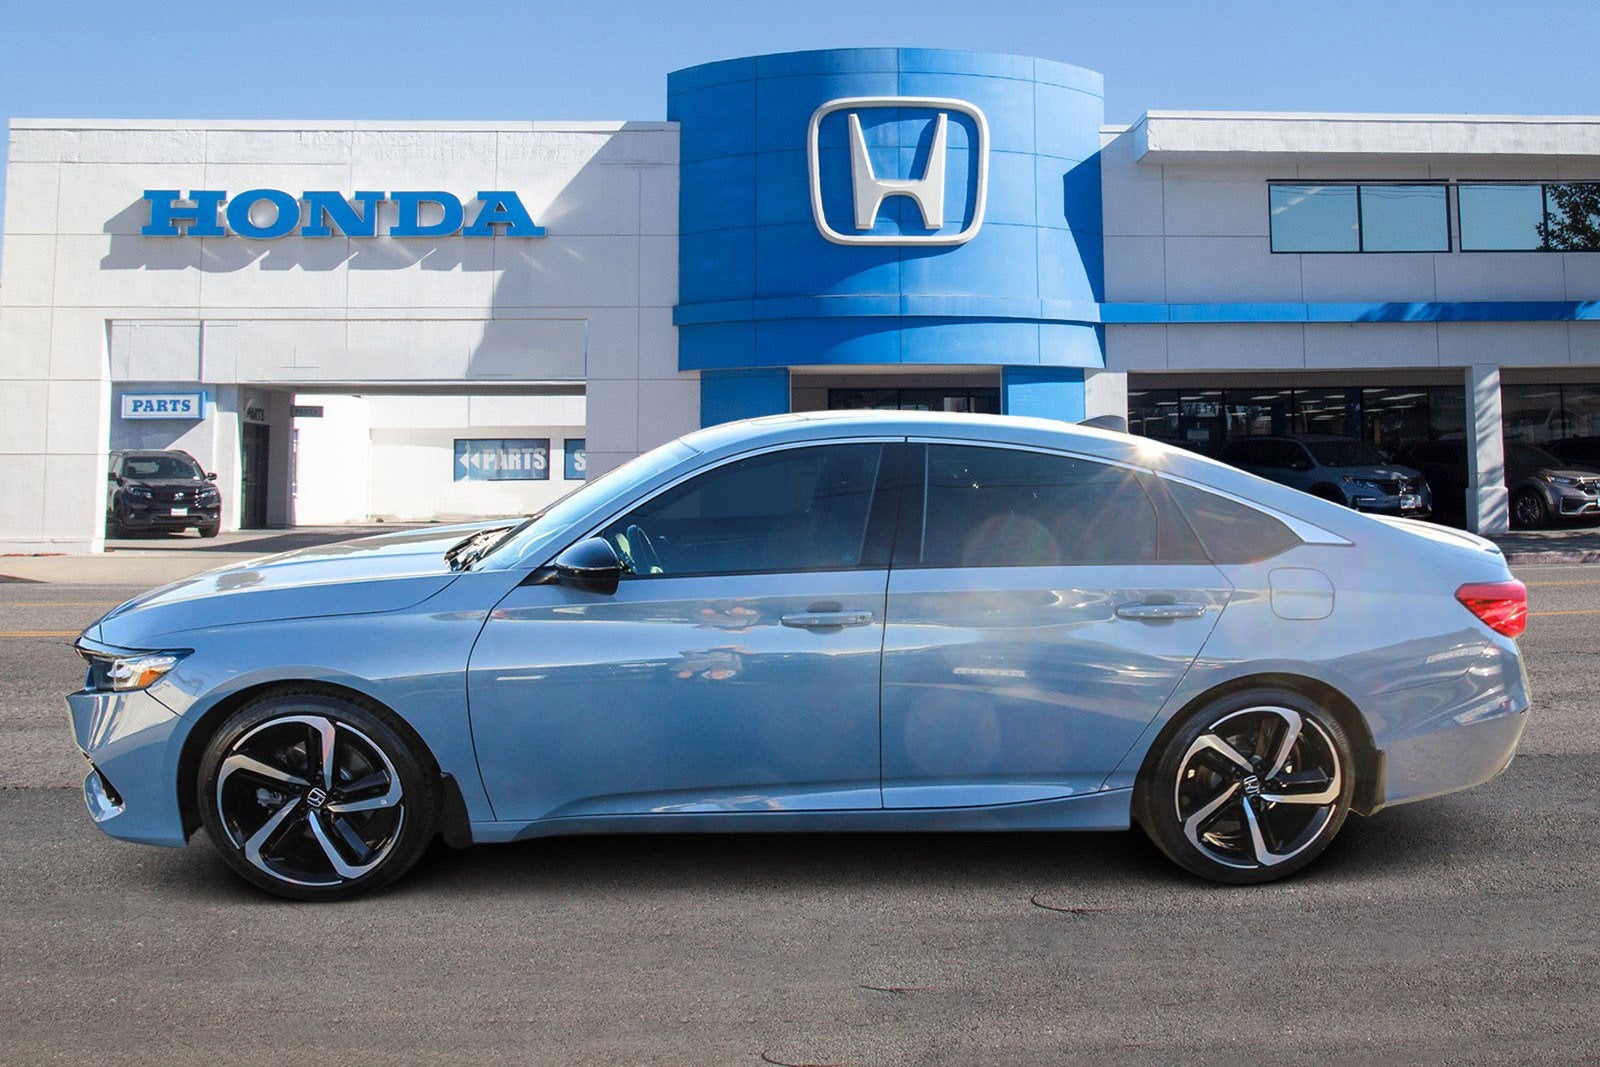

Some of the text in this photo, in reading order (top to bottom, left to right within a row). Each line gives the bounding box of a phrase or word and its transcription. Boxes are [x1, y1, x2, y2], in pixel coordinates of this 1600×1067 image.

[141, 188, 547, 239] HONDA
[132, 399, 191, 412] PARTS
[482, 447, 547, 471] PARTS
